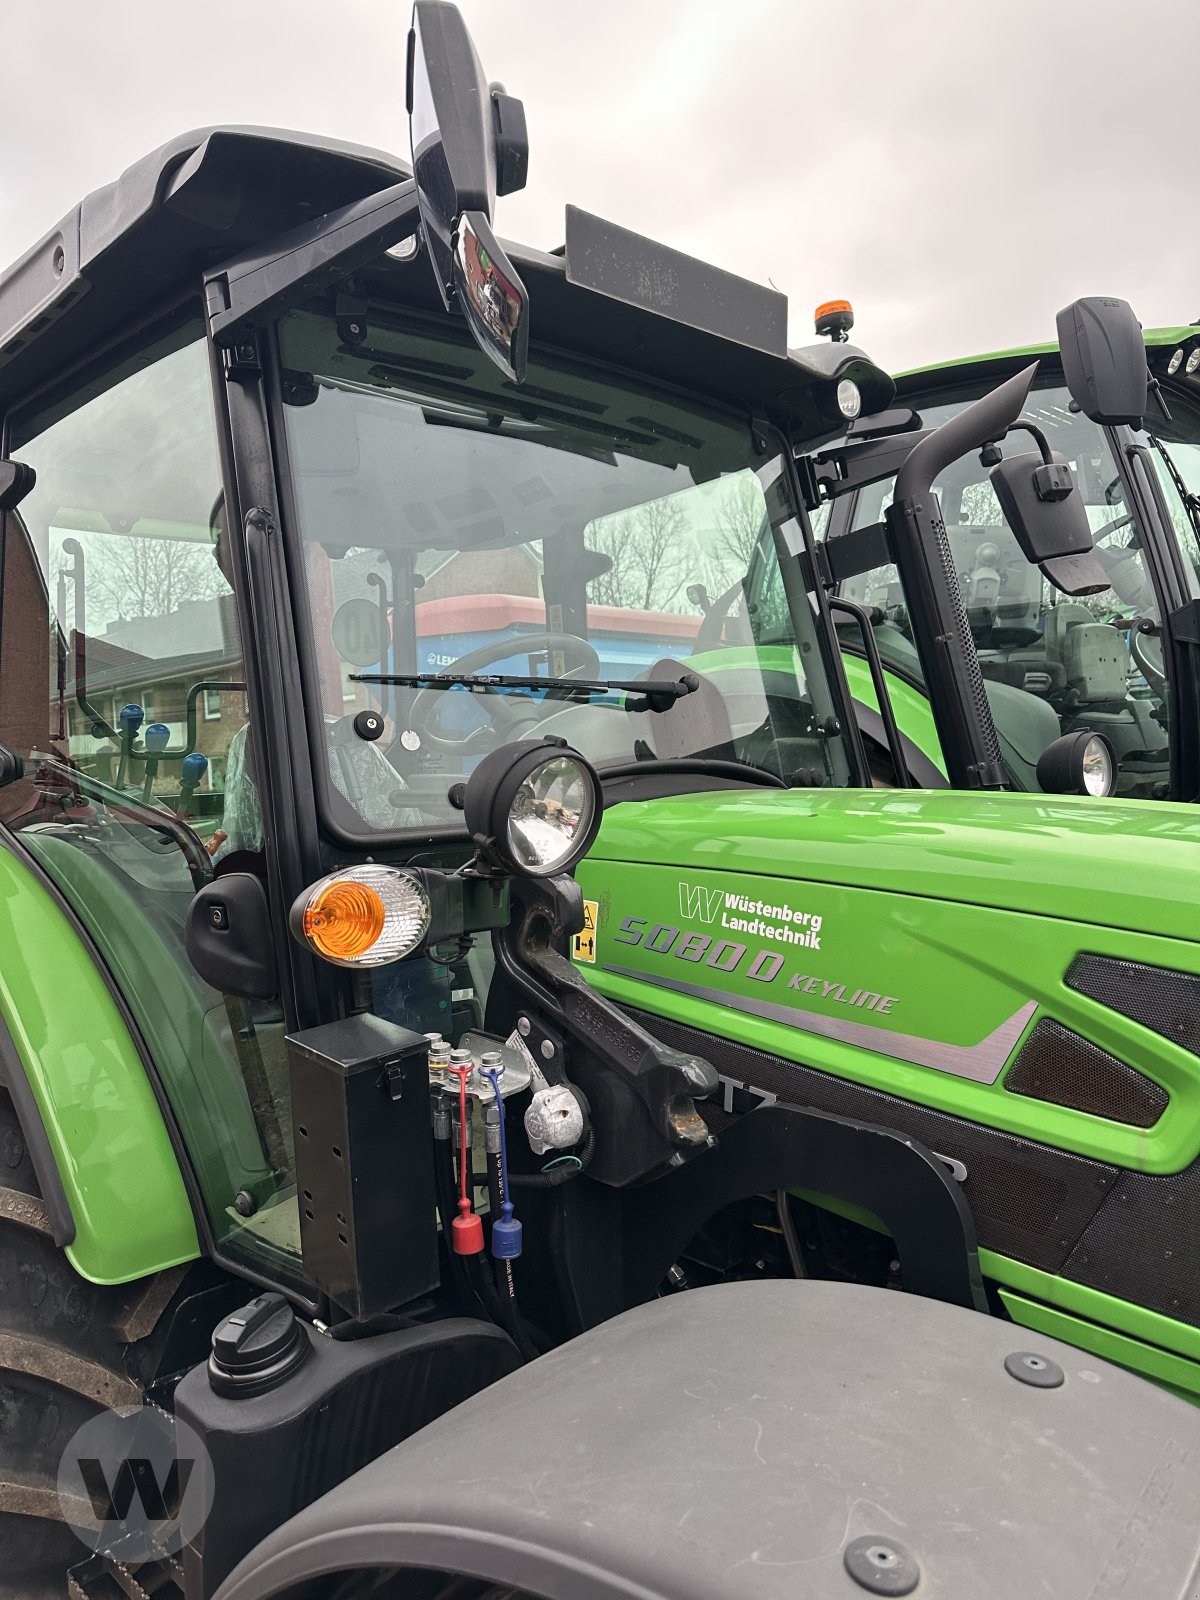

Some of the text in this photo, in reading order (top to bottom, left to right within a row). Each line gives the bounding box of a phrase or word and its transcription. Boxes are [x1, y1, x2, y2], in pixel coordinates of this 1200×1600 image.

[437, 655, 460, 666] LEM
[721, 912, 822, 950] Landtechnik
[724, 892, 823, 931] Wüstenberg
[613, 915, 785, 983] 5080 D
[787, 972, 900, 1016] KEYLINE
